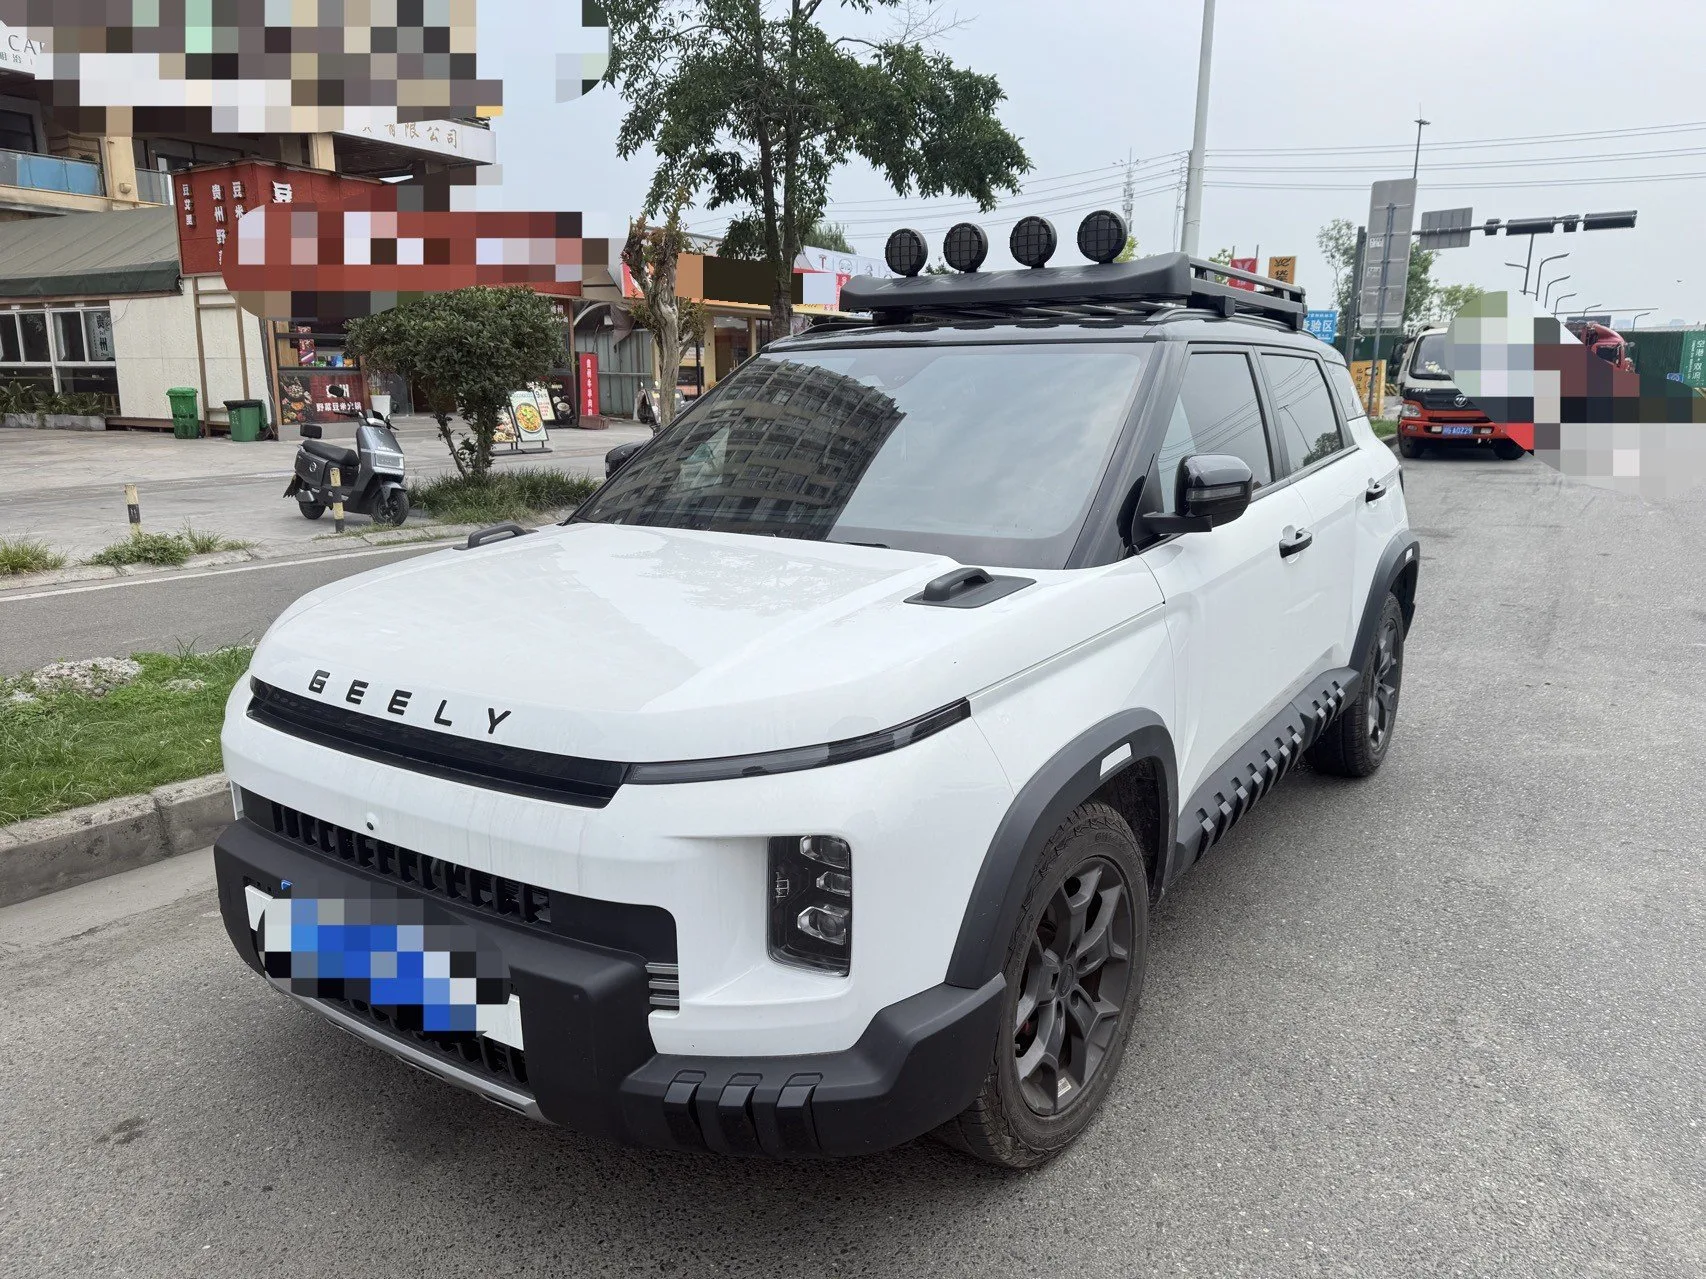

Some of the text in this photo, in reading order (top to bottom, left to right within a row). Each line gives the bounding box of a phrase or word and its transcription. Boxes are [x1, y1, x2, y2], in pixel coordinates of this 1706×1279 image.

[8, 34, 43, 55] CA
[363, 122, 457, 148] 有限公司
[211, 183, 226, 265] 贵州野
[308, 669, 511, 734] GEELY
